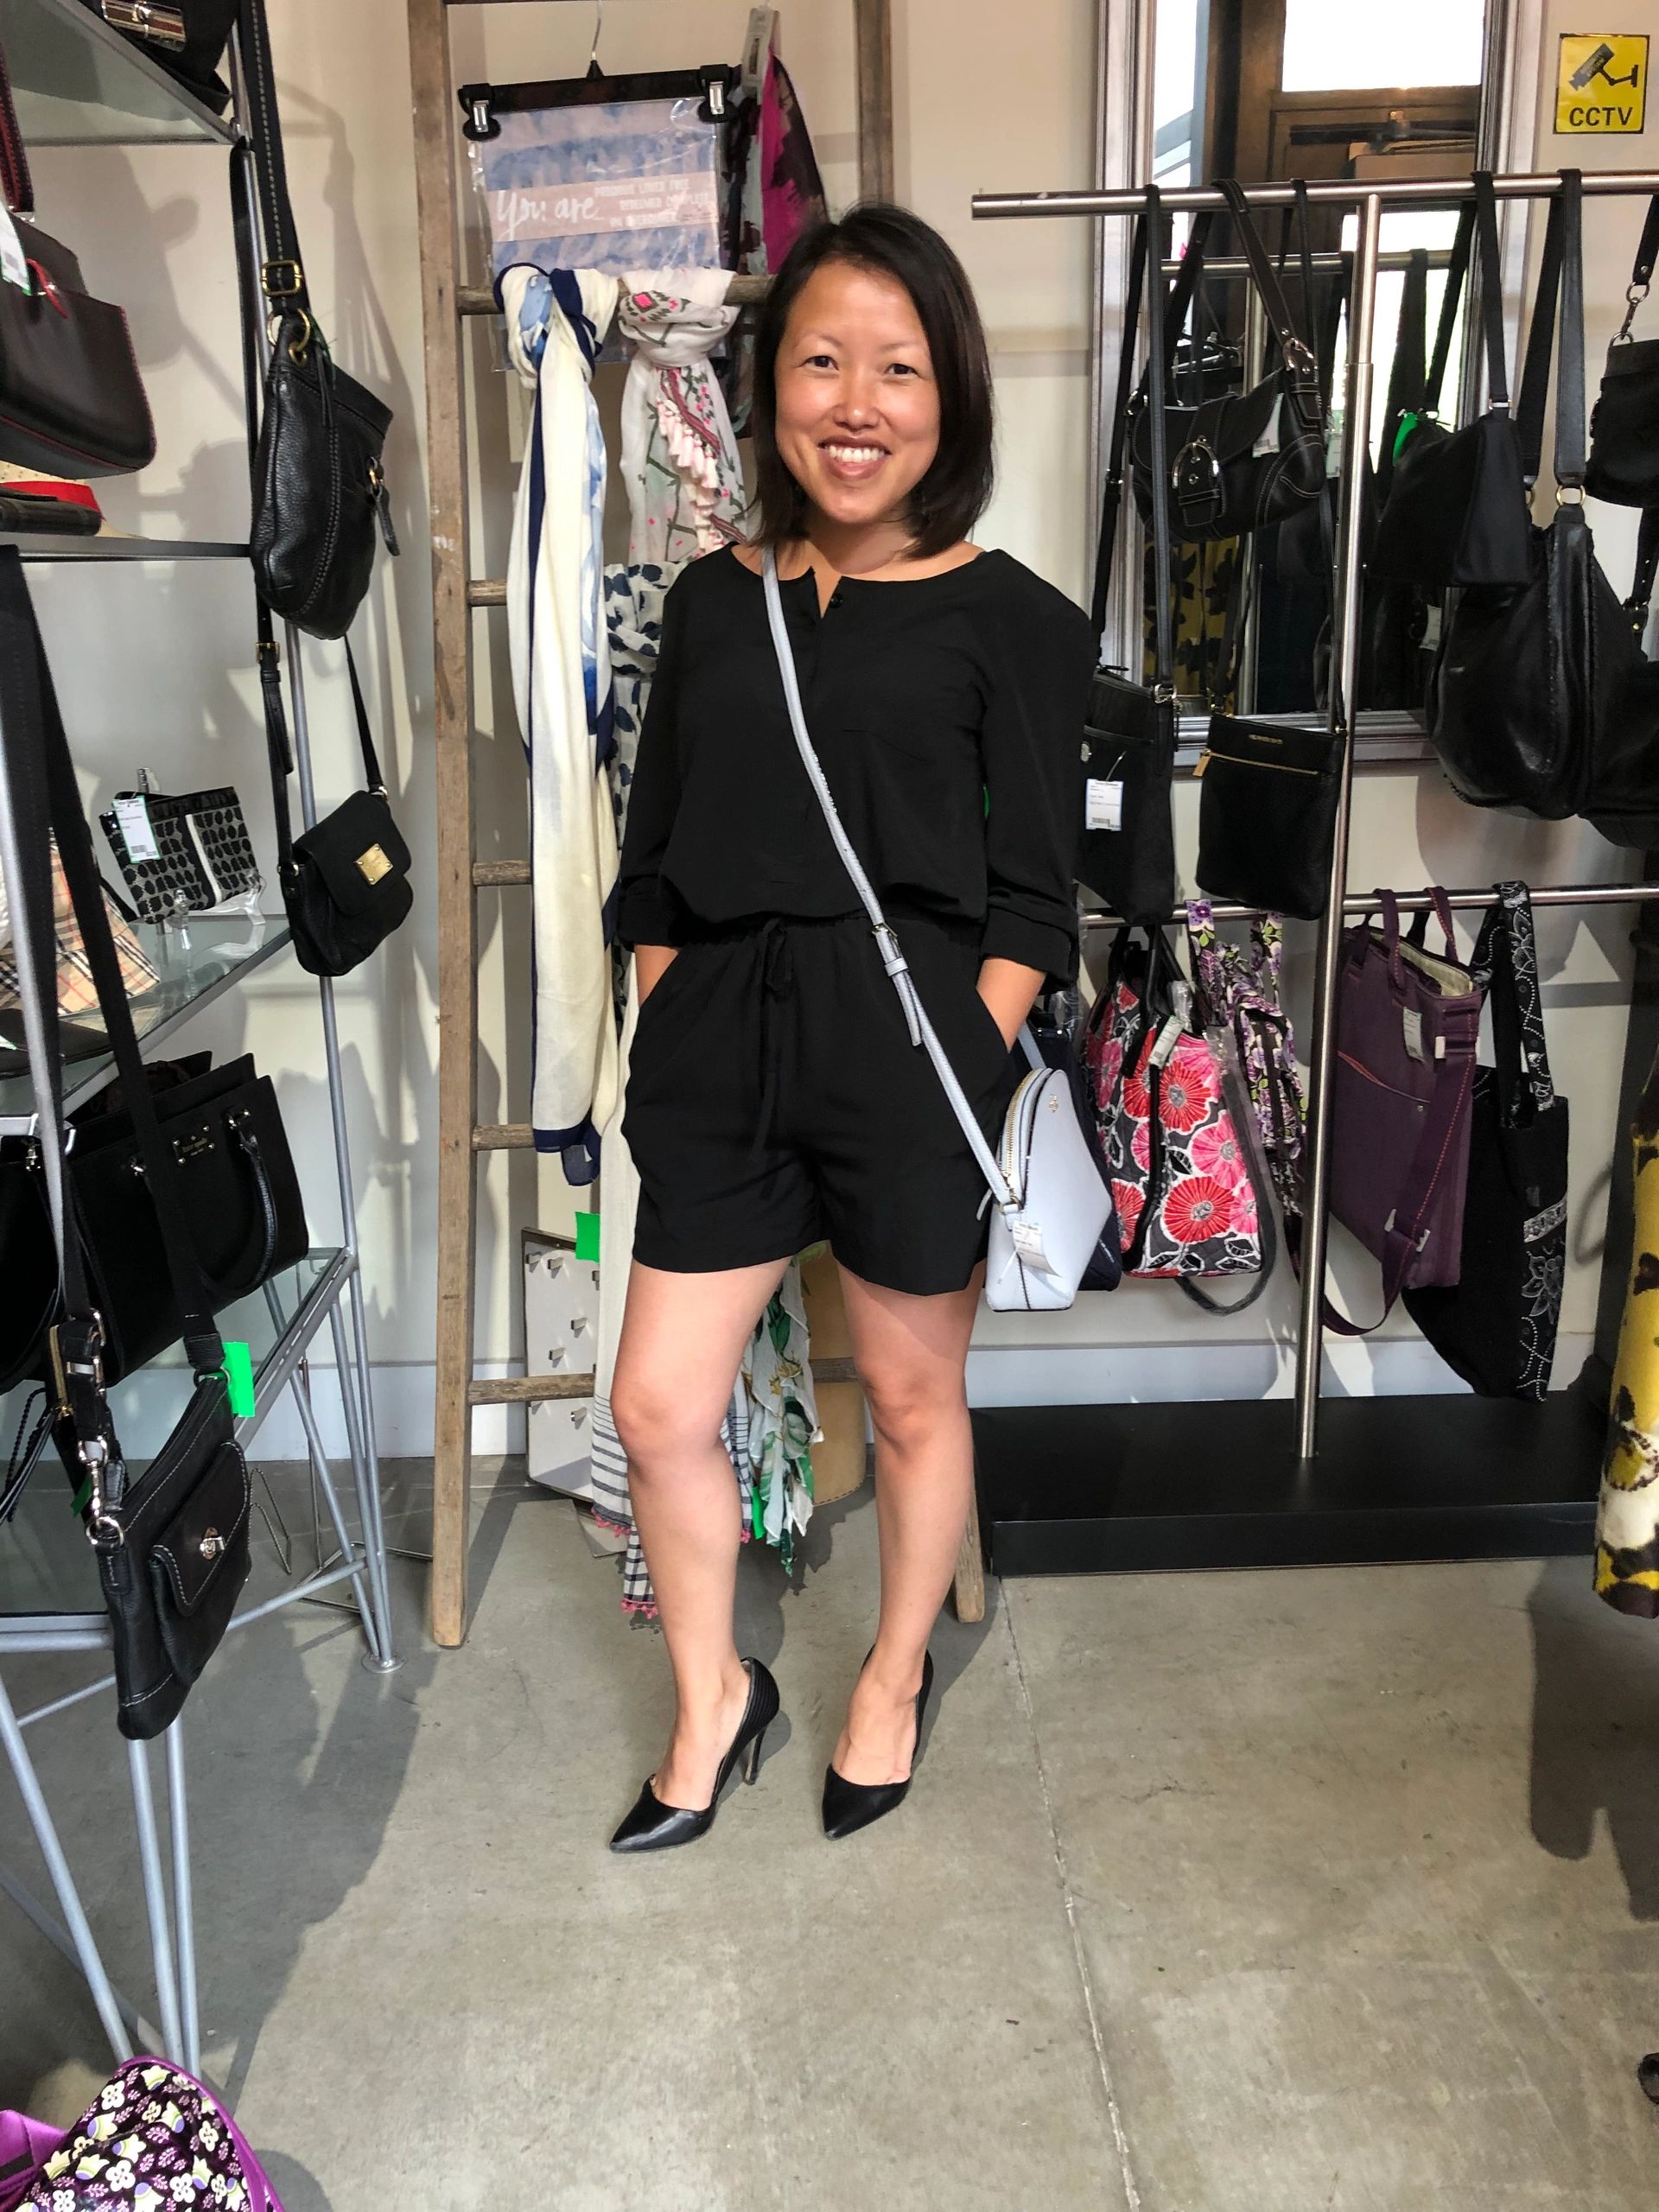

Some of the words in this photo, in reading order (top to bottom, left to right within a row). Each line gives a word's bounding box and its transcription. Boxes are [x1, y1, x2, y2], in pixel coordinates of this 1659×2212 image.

[1569, 106, 1633, 127] CCTV
[498, 189, 547, 242] You
[554, 197, 601, 224] are
